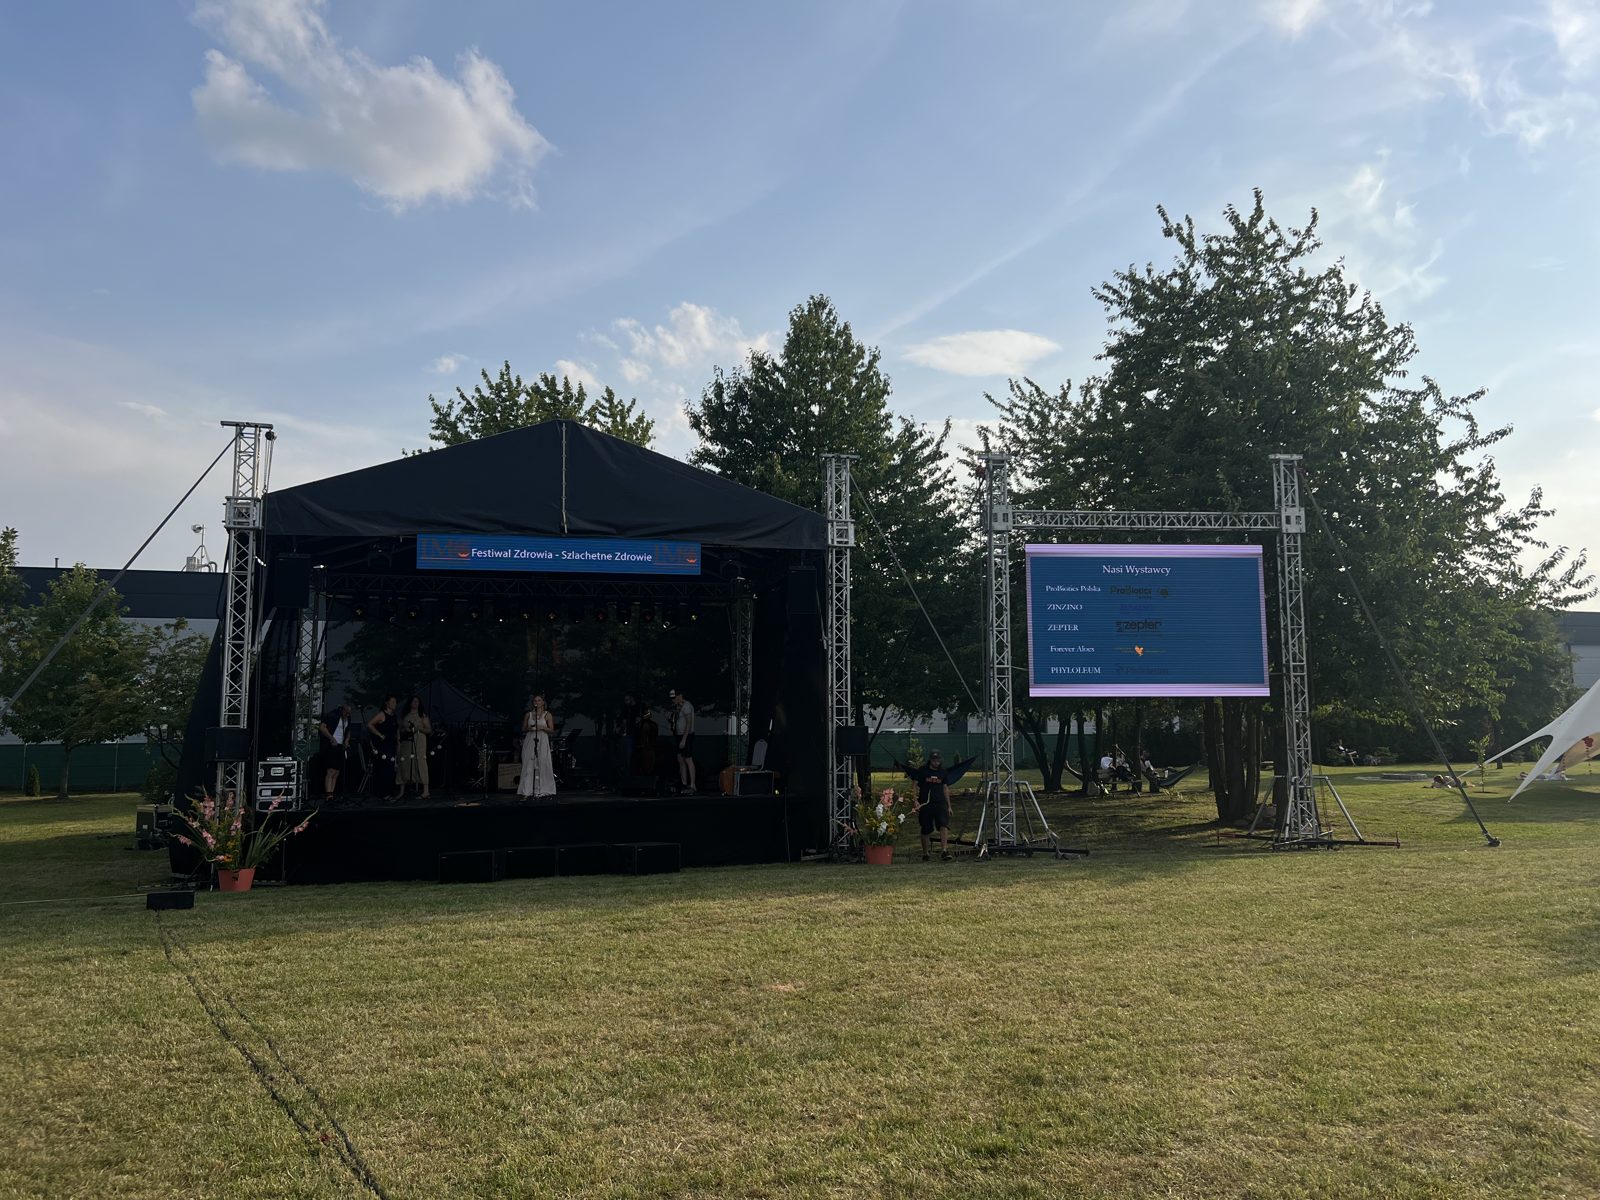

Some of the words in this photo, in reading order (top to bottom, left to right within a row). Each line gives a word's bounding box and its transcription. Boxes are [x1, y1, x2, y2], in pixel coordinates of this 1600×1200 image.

[471, 548, 511, 558] Festiwal
[514, 549, 553, 559] Zdrowia
[561, 550, 612, 560] Szlachetne
[615, 552, 652, 561] Zdrowie
[1102, 565, 1123, 573] Nasi
[1125, 565, 1171, 576] Wystawcy
[1047, 603, 1083, 611] ZINZINO
